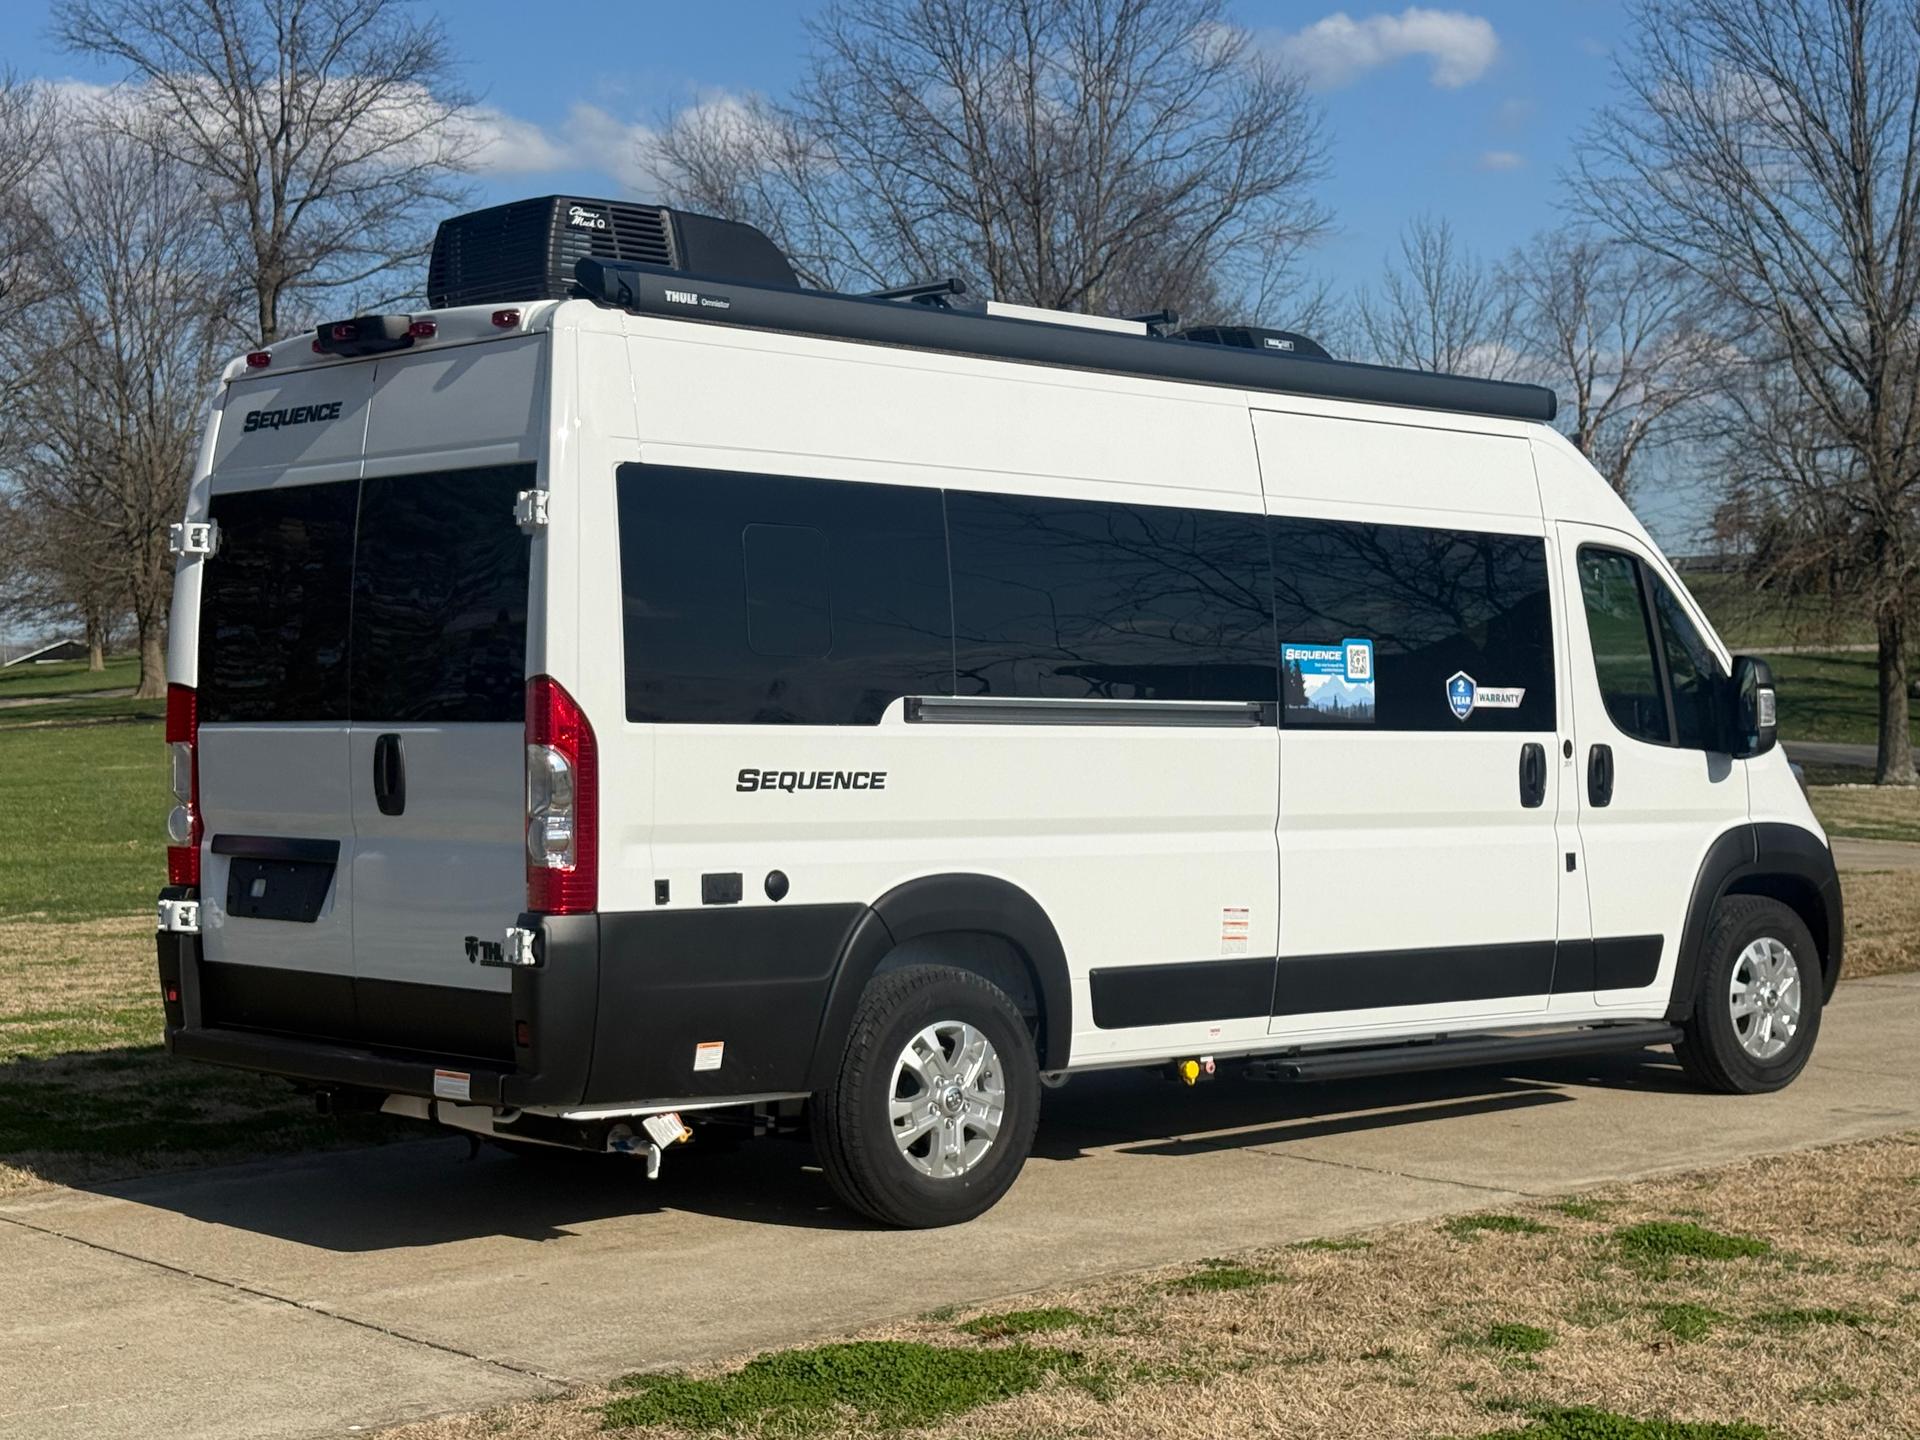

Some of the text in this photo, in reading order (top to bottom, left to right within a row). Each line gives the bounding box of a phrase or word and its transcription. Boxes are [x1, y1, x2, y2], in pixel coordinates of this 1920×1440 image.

[665, 290, 698, 305] THULE
[244, 402, 342, 432] SEQUENCE
[1286, 649, 1342, 661] SEQUENCE
[1458, 680, 1464, 692] 2
[1453, 696, 1471, 705] YEAR
[1480, 694, 1519, 703] WARRANTY
[736, 768, 887, 793] SEQUENCE
